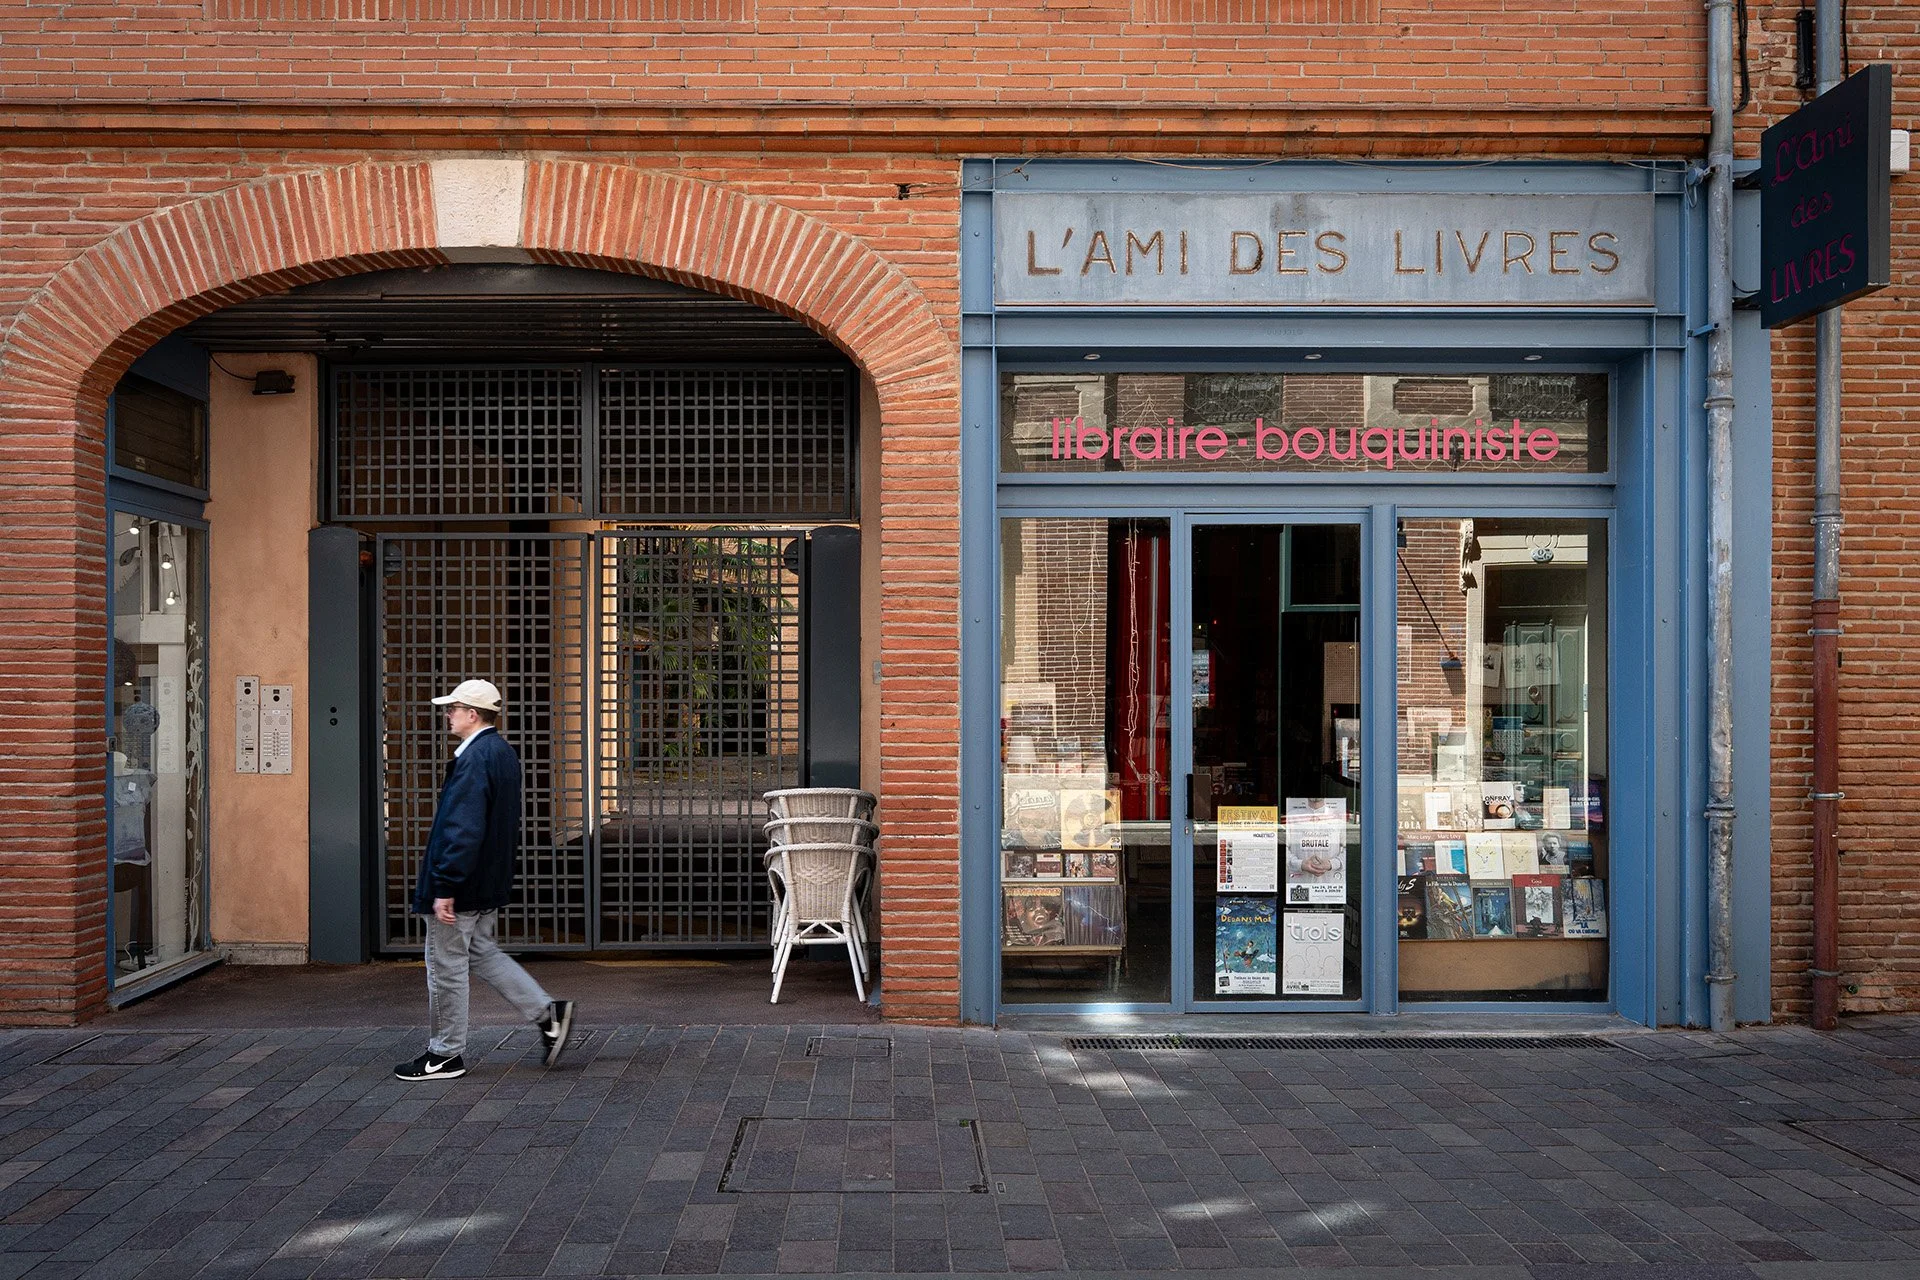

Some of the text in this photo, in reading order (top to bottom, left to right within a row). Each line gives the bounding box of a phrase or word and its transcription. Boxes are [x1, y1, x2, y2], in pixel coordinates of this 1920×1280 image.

[1790, 191, 1834, 228] des
[1027, 226, 1621, 277] L'AMI DES LIVRES
[1770, 233, 1856, 304] LIVRES
[1220, 809, 1275, 821] FESTIVAL
[1399, 820, 1421, 830] ZOLA
[1301, 839, 1329, 848] BRUTALE
[1220, 914, 1253, 923] DEDANS
[1286, 916, 1341, 942] trois
